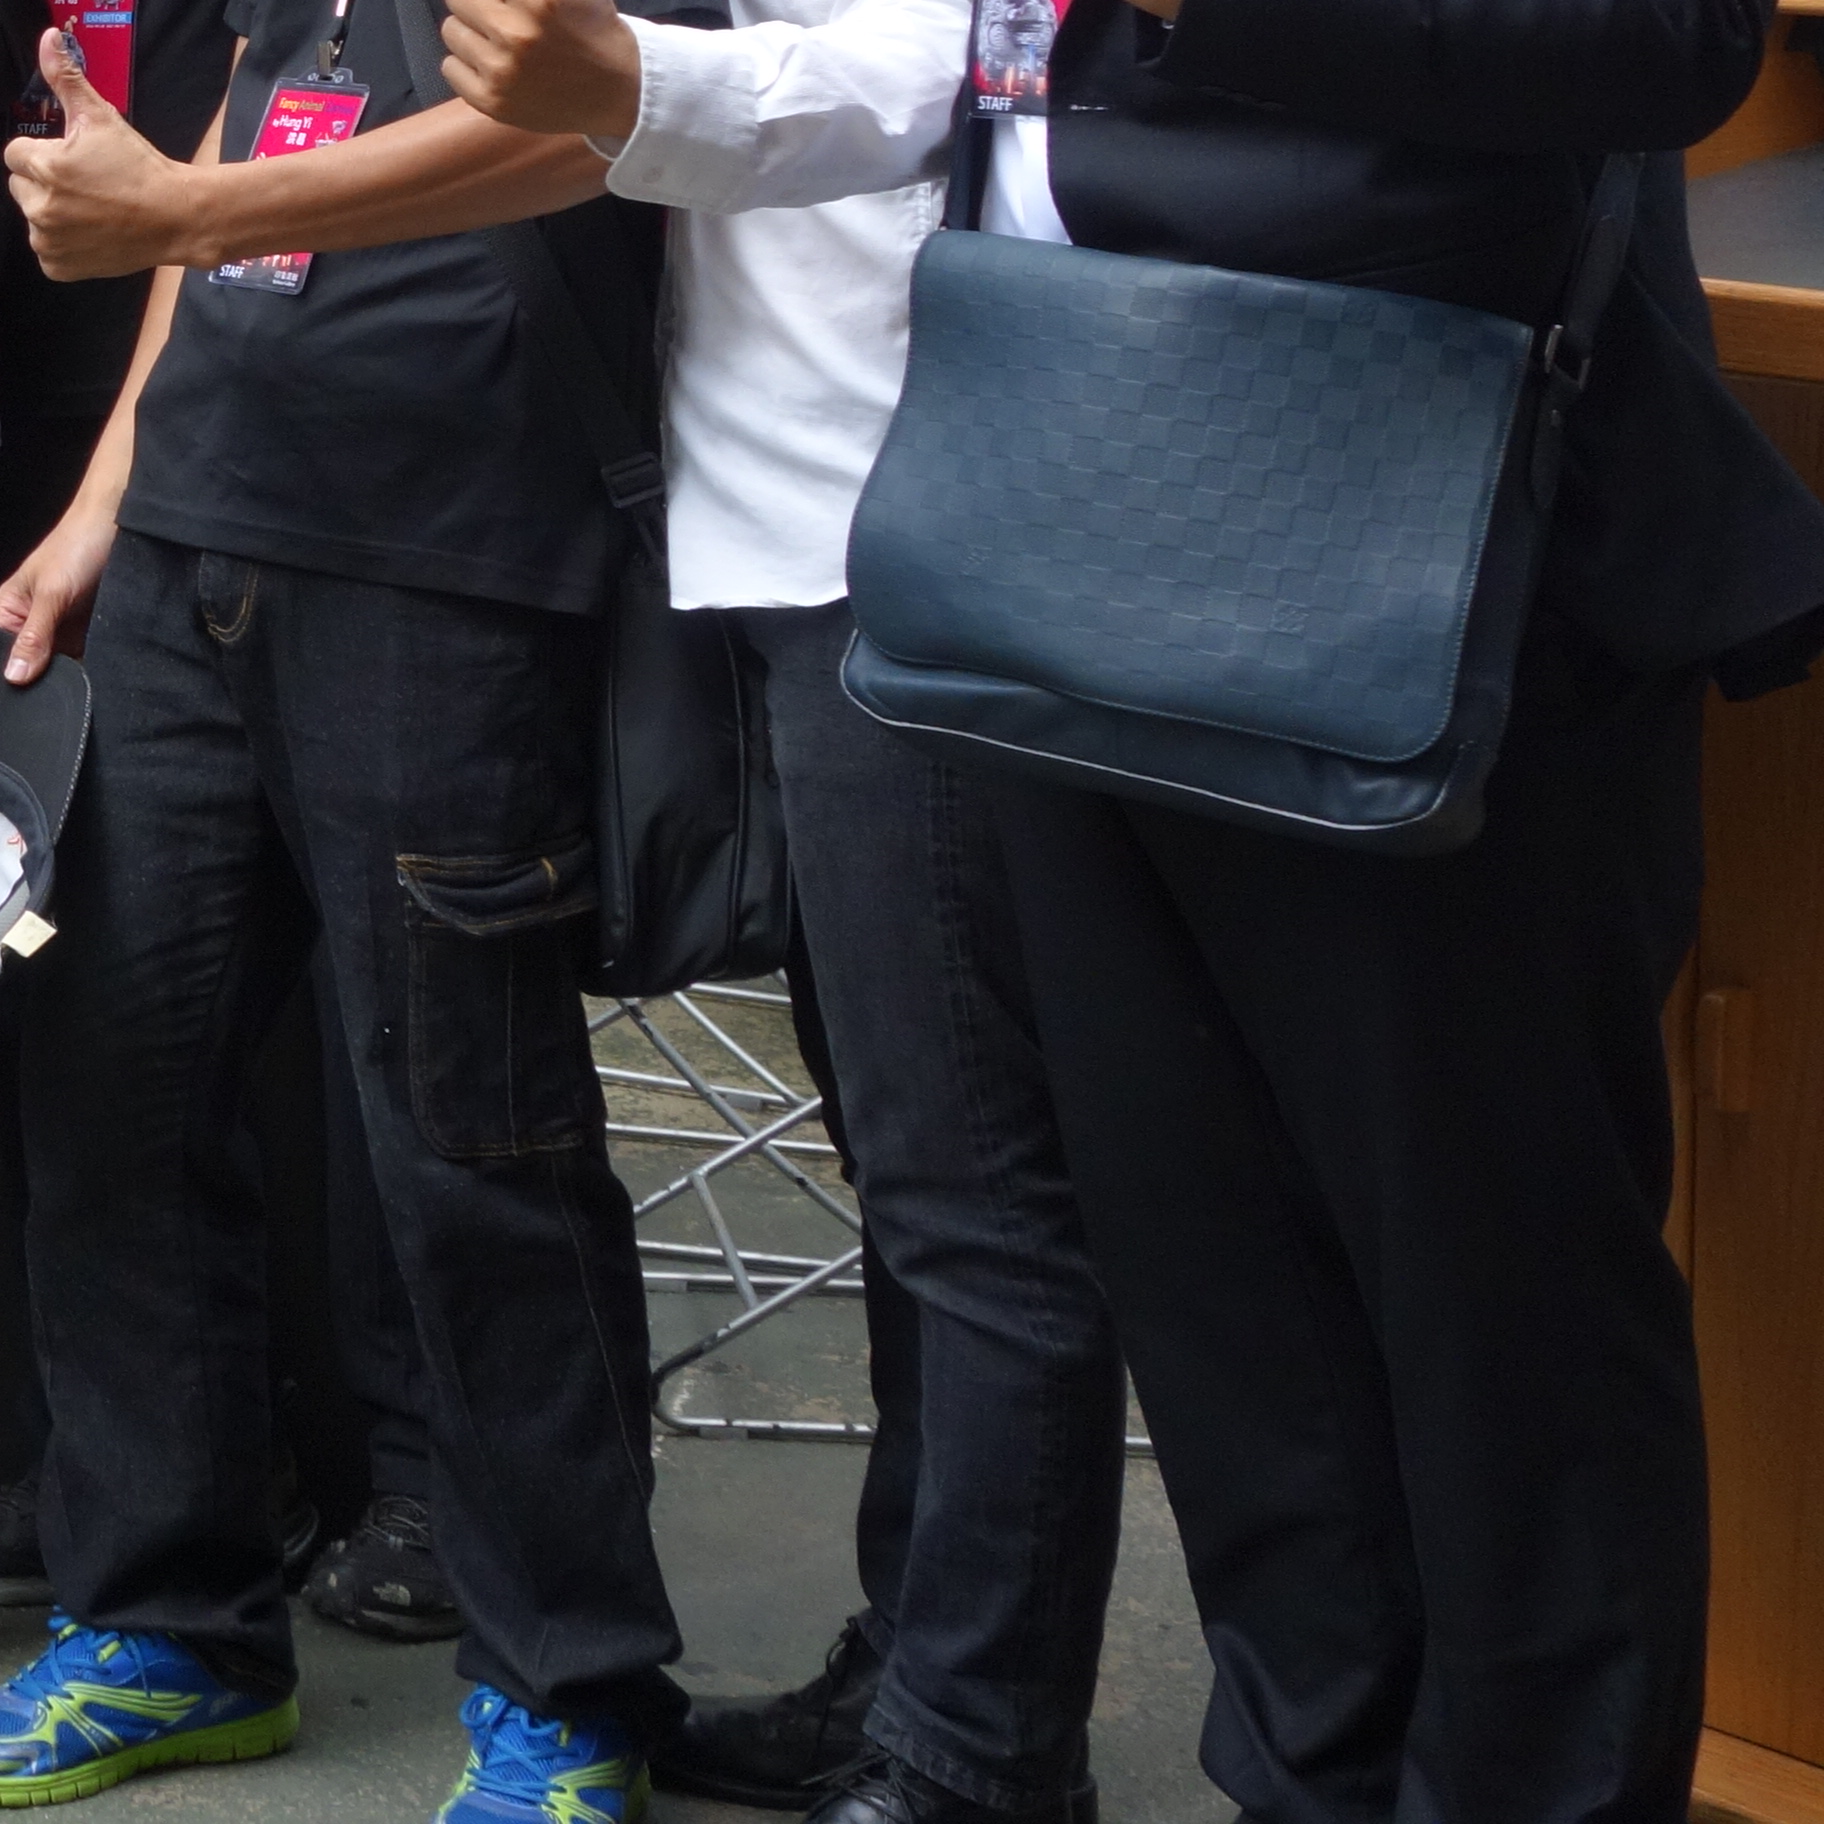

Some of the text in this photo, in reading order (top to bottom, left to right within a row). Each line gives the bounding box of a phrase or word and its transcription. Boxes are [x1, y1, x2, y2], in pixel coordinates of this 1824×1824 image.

[977, 96, 1014, 112] STAFF
[17, 123, 48, 135] STAFF
[219, 265, 246, 279] STAFF
